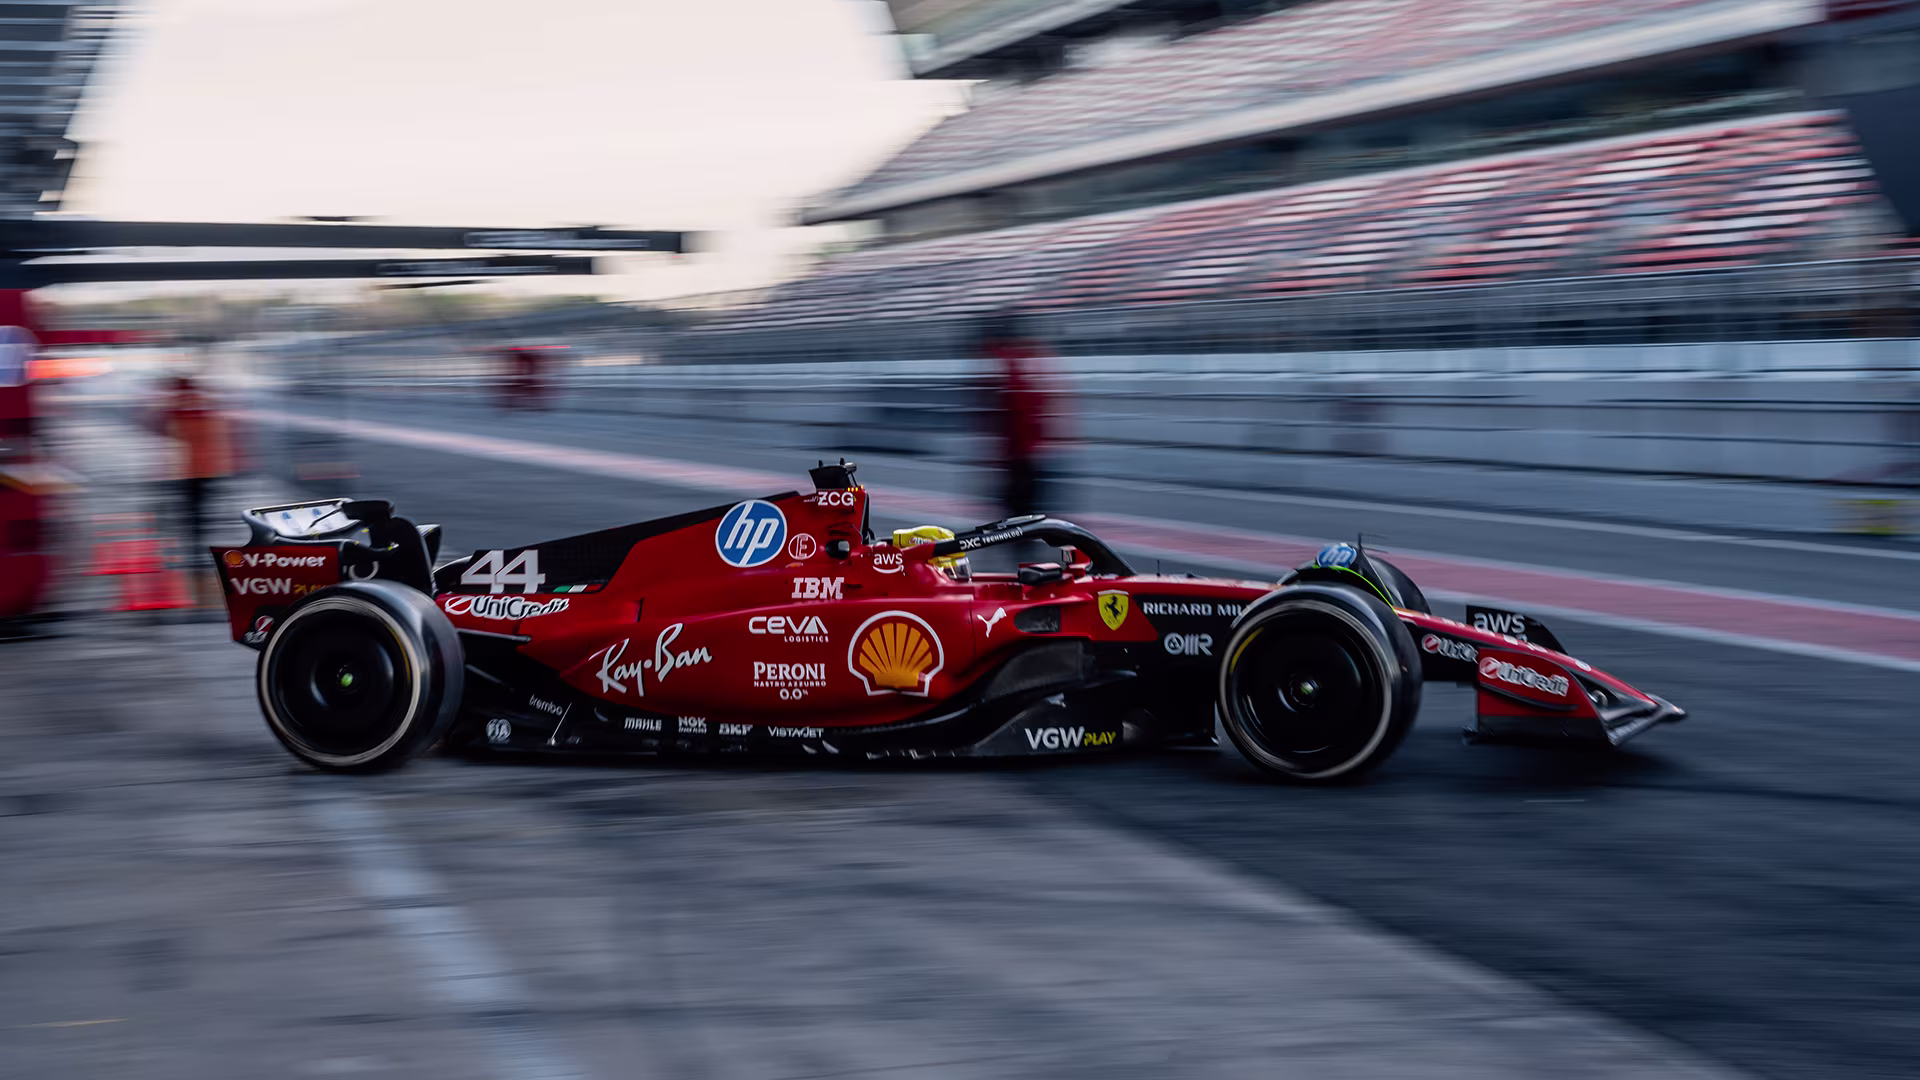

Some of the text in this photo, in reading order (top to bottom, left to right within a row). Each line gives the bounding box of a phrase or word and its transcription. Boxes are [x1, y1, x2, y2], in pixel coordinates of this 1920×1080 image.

[817, 491, 854, 507] ZCG
[724, 501, 780, 566] hp
[981, 525, 1023, 545] TECHNOLOGY
[243, 553, 326, 568] V-Power
[873, 552, 903, 566] aws
[460, 549, 546, 594] 44
[230, 577, 292, 596] VGW
[791, 576, 845, 600] IBM
[470, 595, 570, 620] UniCredit
[1143, 602, 1213, 617] RICHARD
[1473, 611, 1526, 636] aws
[784, 635, 829, 643] LOGISTICS
[753, 661, 826, 681] PERONI
[754, 680, 827, 688] NASTRO AZZURRO
[529, 694, 563, 716] brembo
[624, 717, 662, 732] MAHLE
[1024, 726, 1117, 749] VGW PLAY
